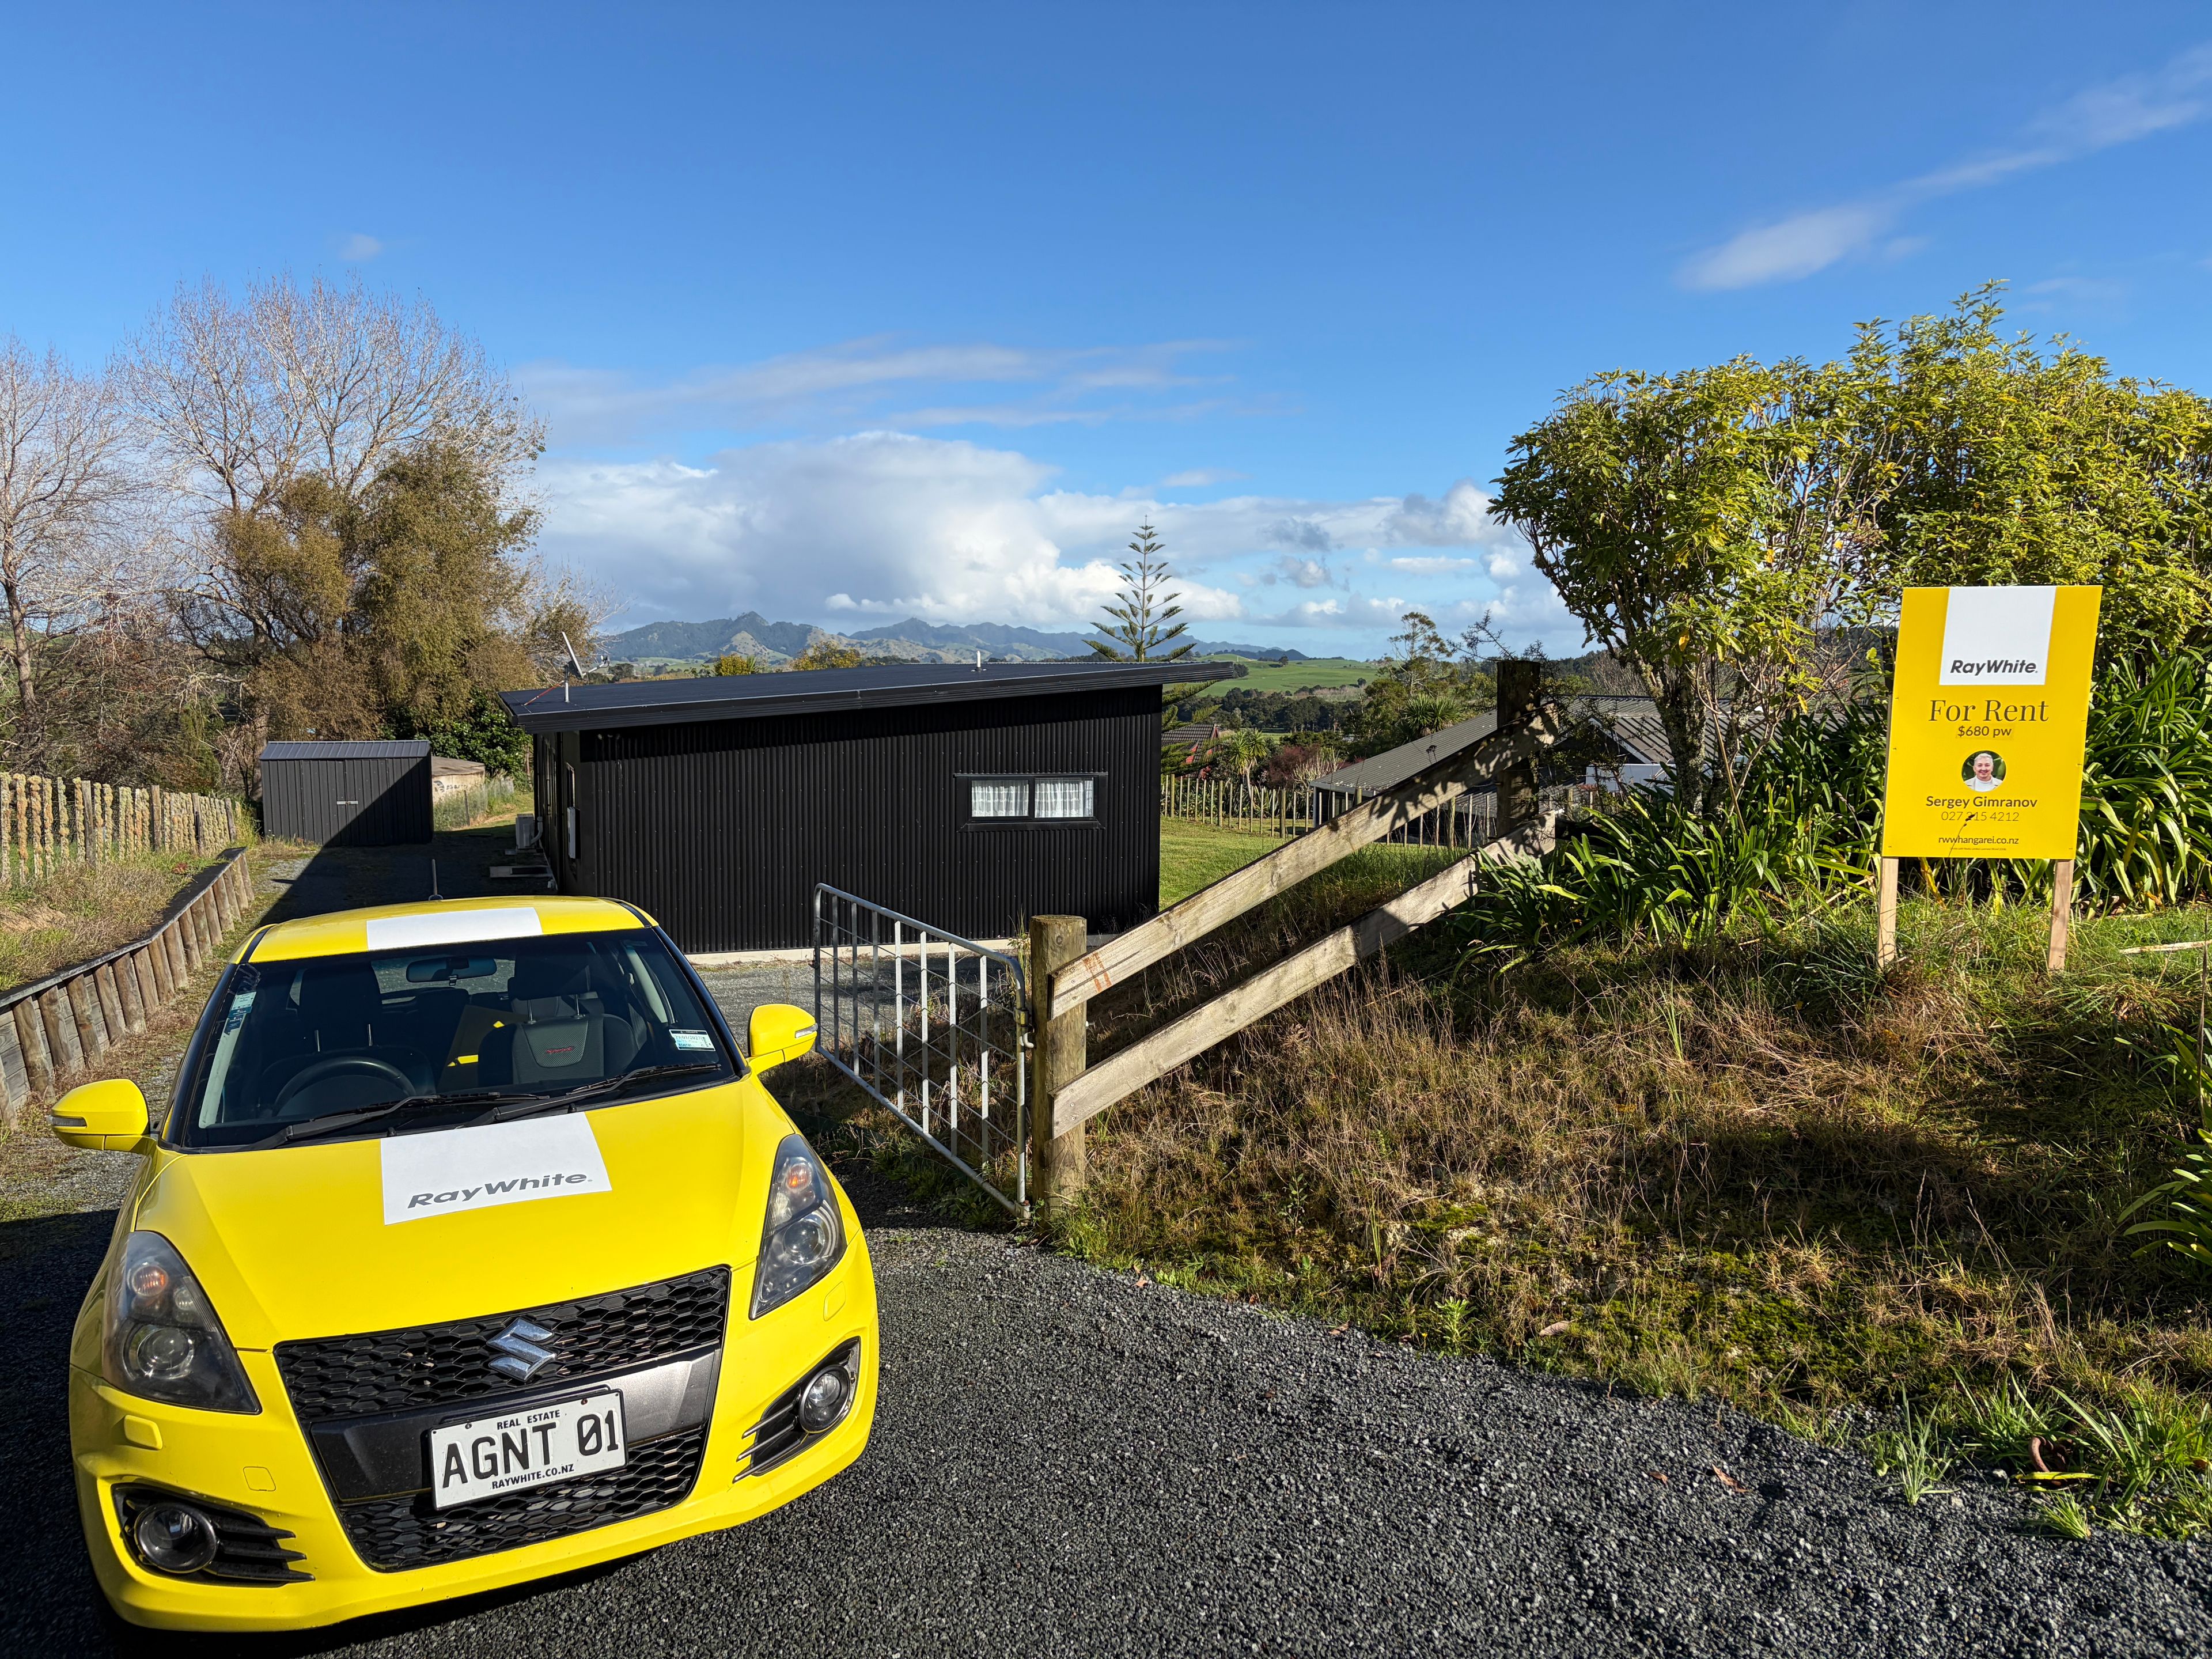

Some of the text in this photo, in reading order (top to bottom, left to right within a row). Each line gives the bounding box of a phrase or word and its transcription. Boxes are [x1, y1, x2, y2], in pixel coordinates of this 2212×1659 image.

[1950, 660, 2037, 676] RayWhite
[1929, 700, 2049, 721] For Rent
[1957, 725, 2012, 738] $680 pw
[1926, 796, 2037, 809] Sergey Gimranov
[1941, 811, 1963, 820] 027
[1990, 812, 2019, 821] 4212
[1938, 835, 2019, 845] rwwhangarei.co.nz
[407, 1173, 588, 1209] RayWhite
[497, 1410, 560, 1430] REAL ESTATE
[442, 1410, 619, 1488] AGNT 01
[491, 1464, 574, 1489] RAYWHITE.CO.NZ
